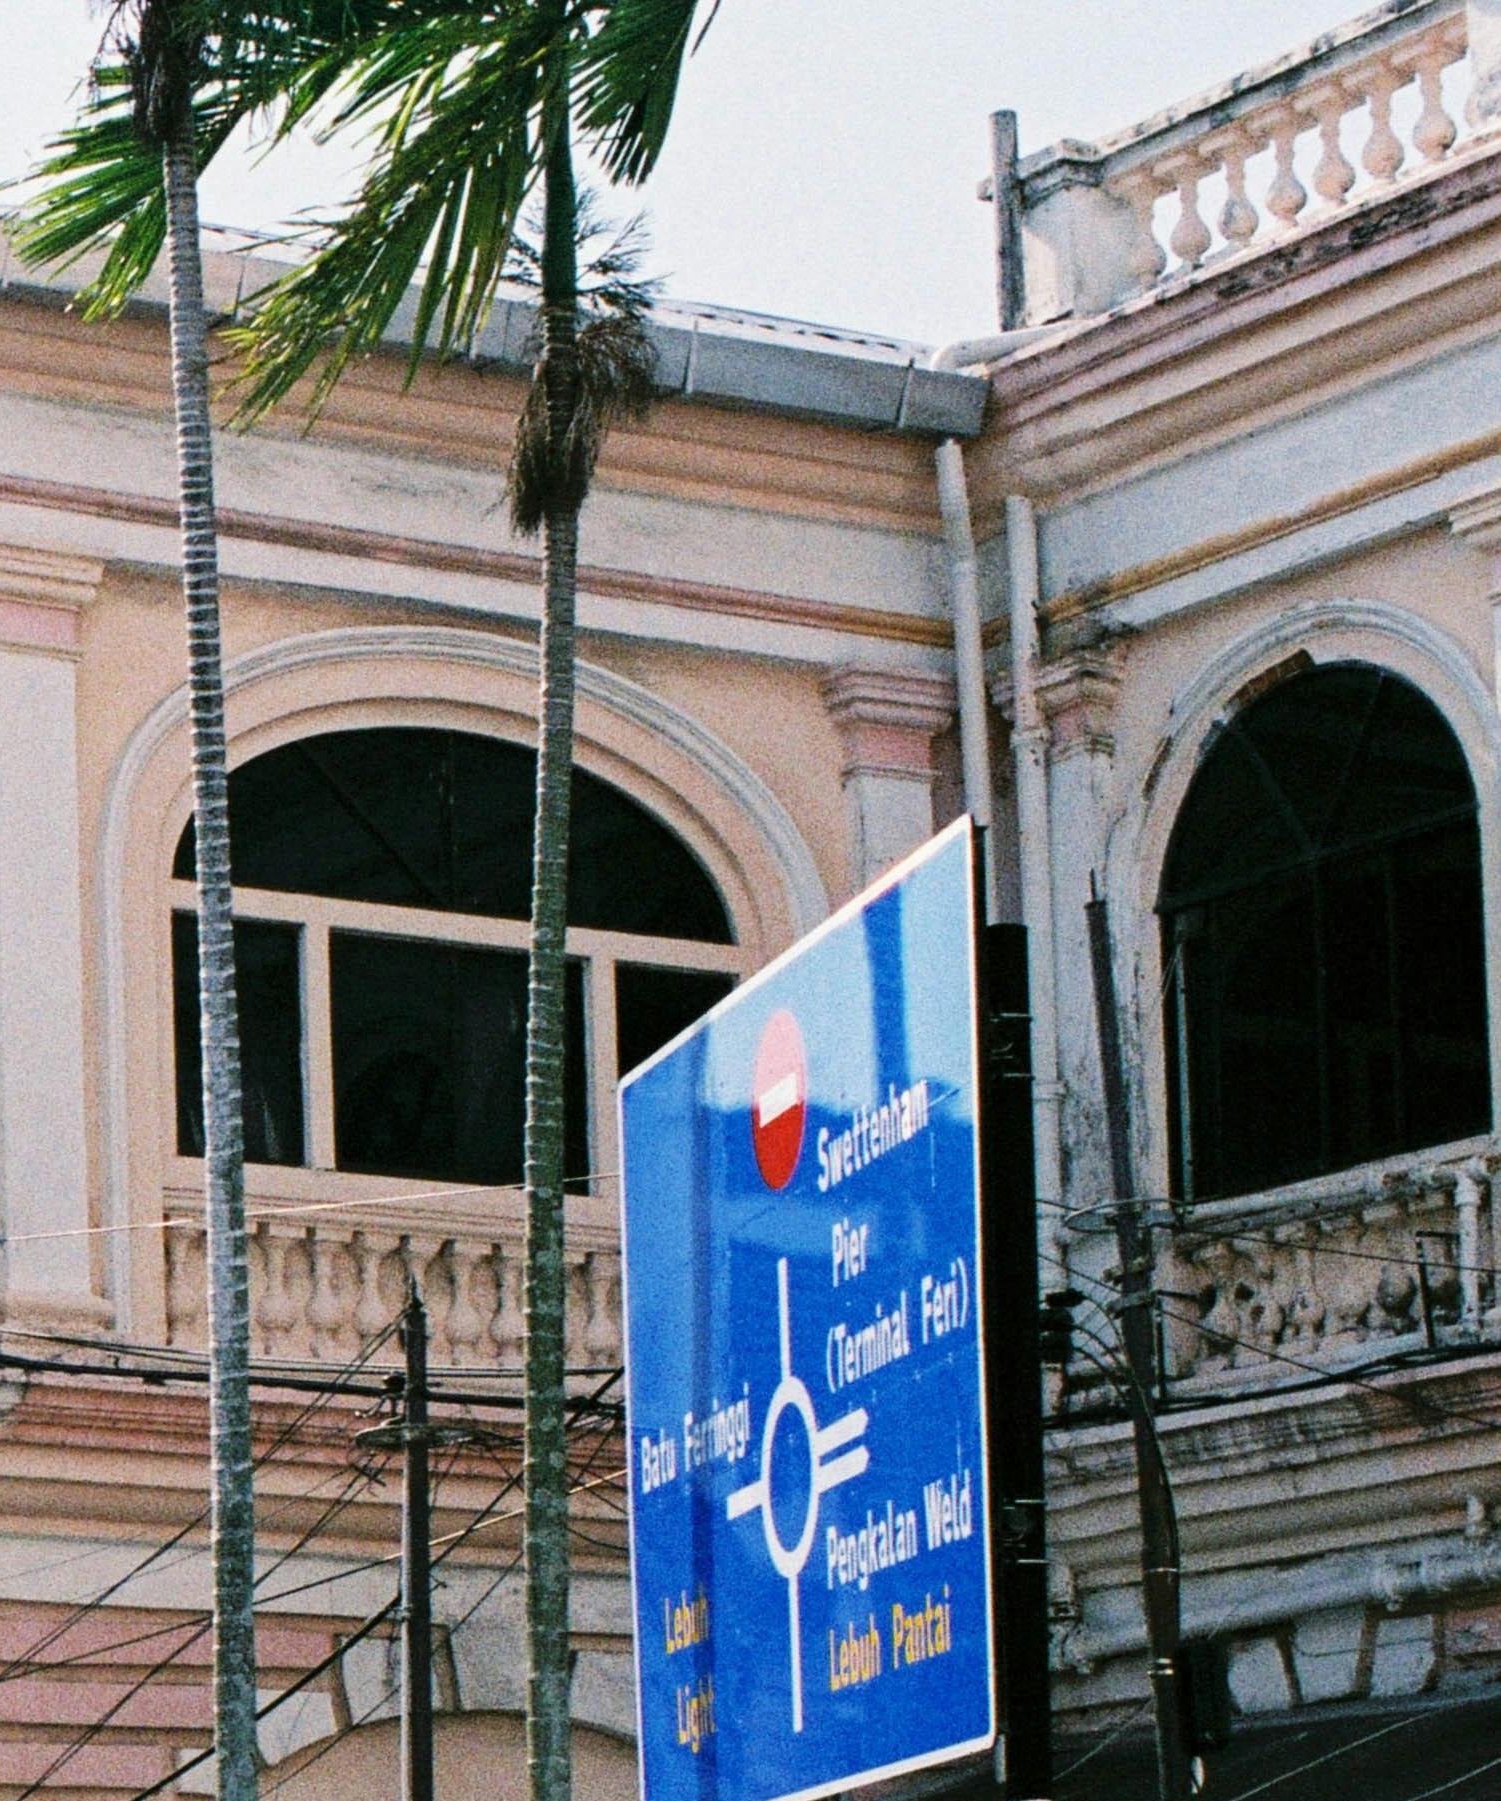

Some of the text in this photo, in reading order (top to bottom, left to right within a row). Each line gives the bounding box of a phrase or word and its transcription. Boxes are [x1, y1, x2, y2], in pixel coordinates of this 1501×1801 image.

[818, 1079, 929, 1192] Swettenham
[831, 1216, 868, 1287] Pier
[826, 1256, 969, 1393] (Terminal Feri)
[641, 1382, 751, 1495] Batu Ferringgi
[826, 1468, 972, 1591] Pengkalan Weld
[663, 1585, 709, 1655] Lebuh
[829, 1583, 951, 1691] Lebuh Pantai
[676, 1673, 716, 1754] Light
